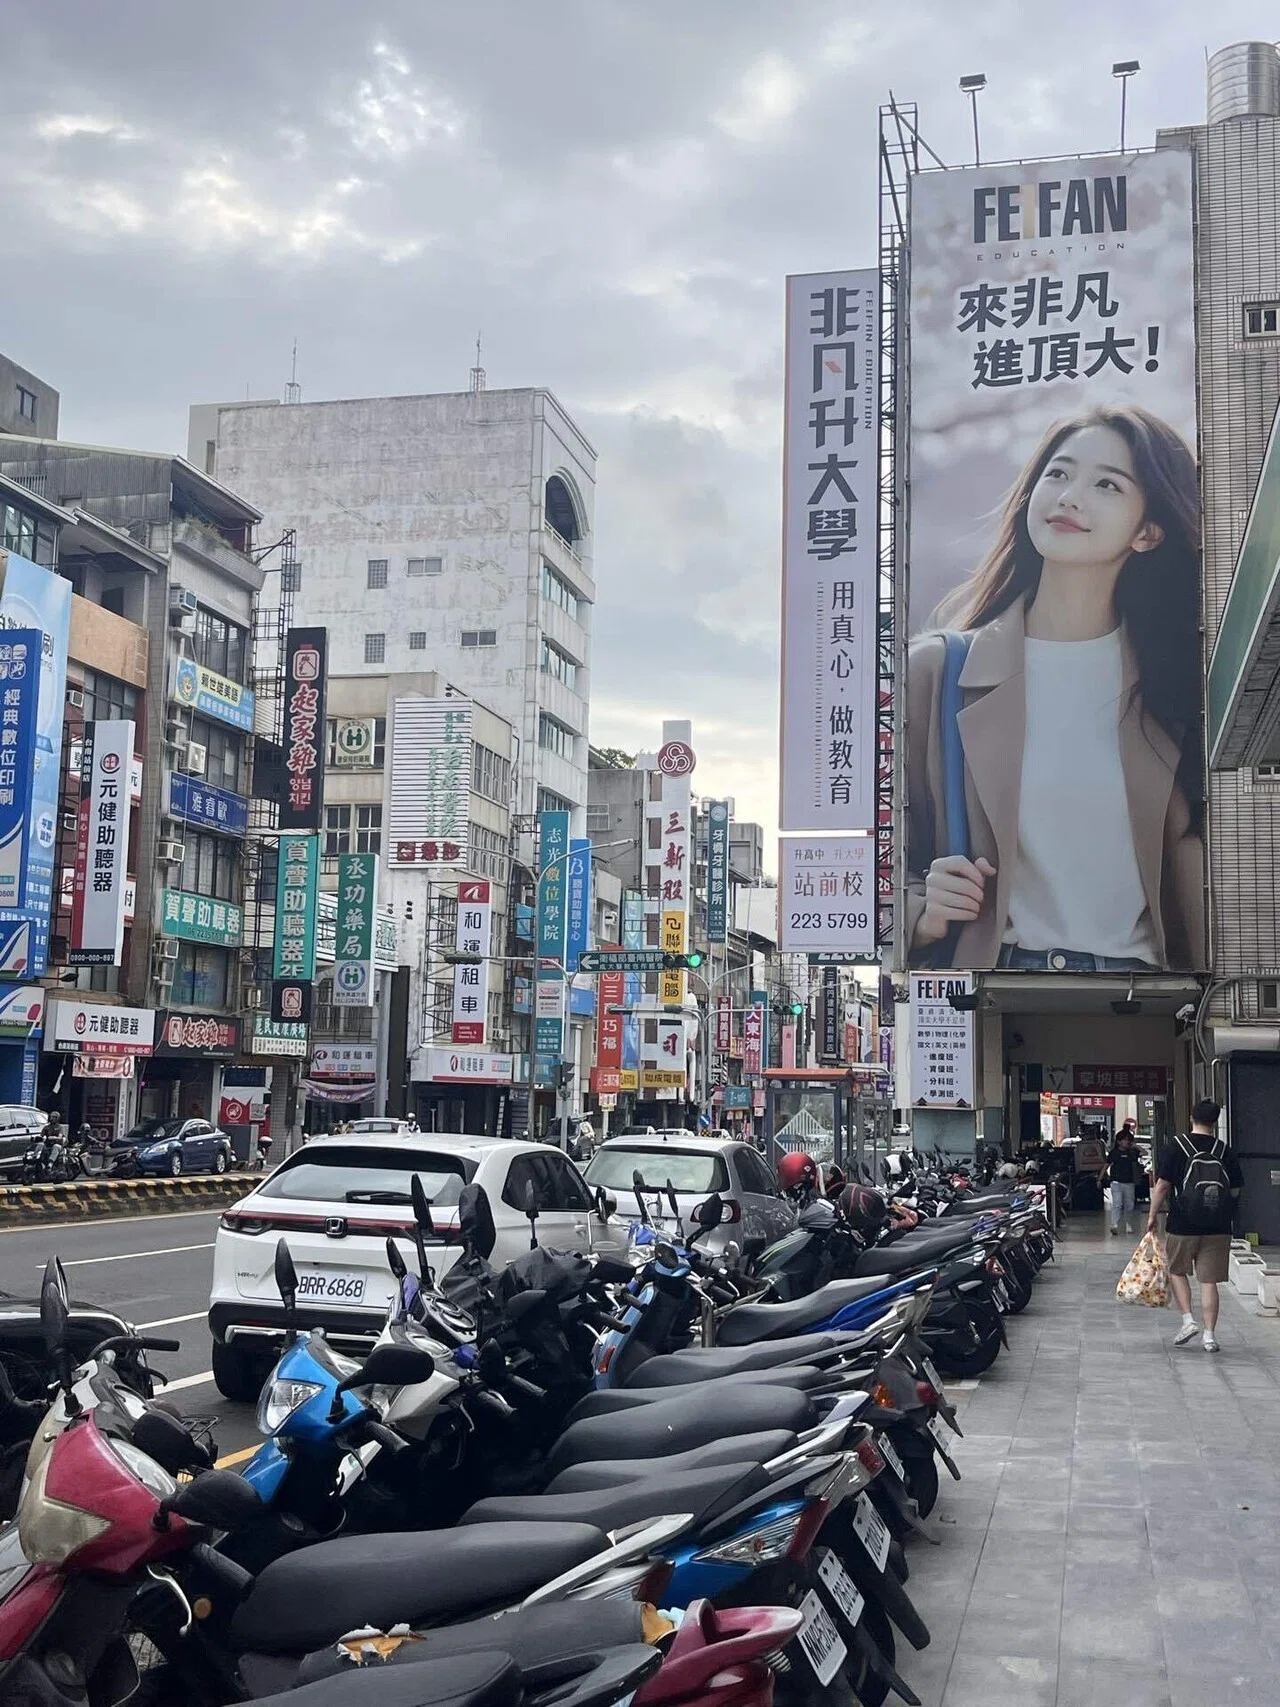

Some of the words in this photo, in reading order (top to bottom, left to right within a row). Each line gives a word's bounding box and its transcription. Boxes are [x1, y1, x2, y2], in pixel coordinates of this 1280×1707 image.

[974, 176, 1127, 243] FEIFAN
[977, 243, 1125, 261] EDUCATION
[957, 271, 1119, 333] 來非凡
[93, 778, 119, 893] 元健助聽器
[663, 811, 685, 901] 三新股
[794, 848, 824, 860] 升高中
[543, 828, 562, 941] 志光數位學院
[794, 870, 864, 897] 站前校
[165, 893, 240, 934] 賀聲助聽器
[341, 857, 368, 958] 丞功藥局
[791, 912, 822, 929] 223
[827, 912, 868, 929] 5799
[461, 911, 483, 1014] 和運租車
[918, 980, 966, 999] FEIFAN
[88, 1014, 139, 1035] 元健助聽器
[662, 1032, 678, 1057] 司
